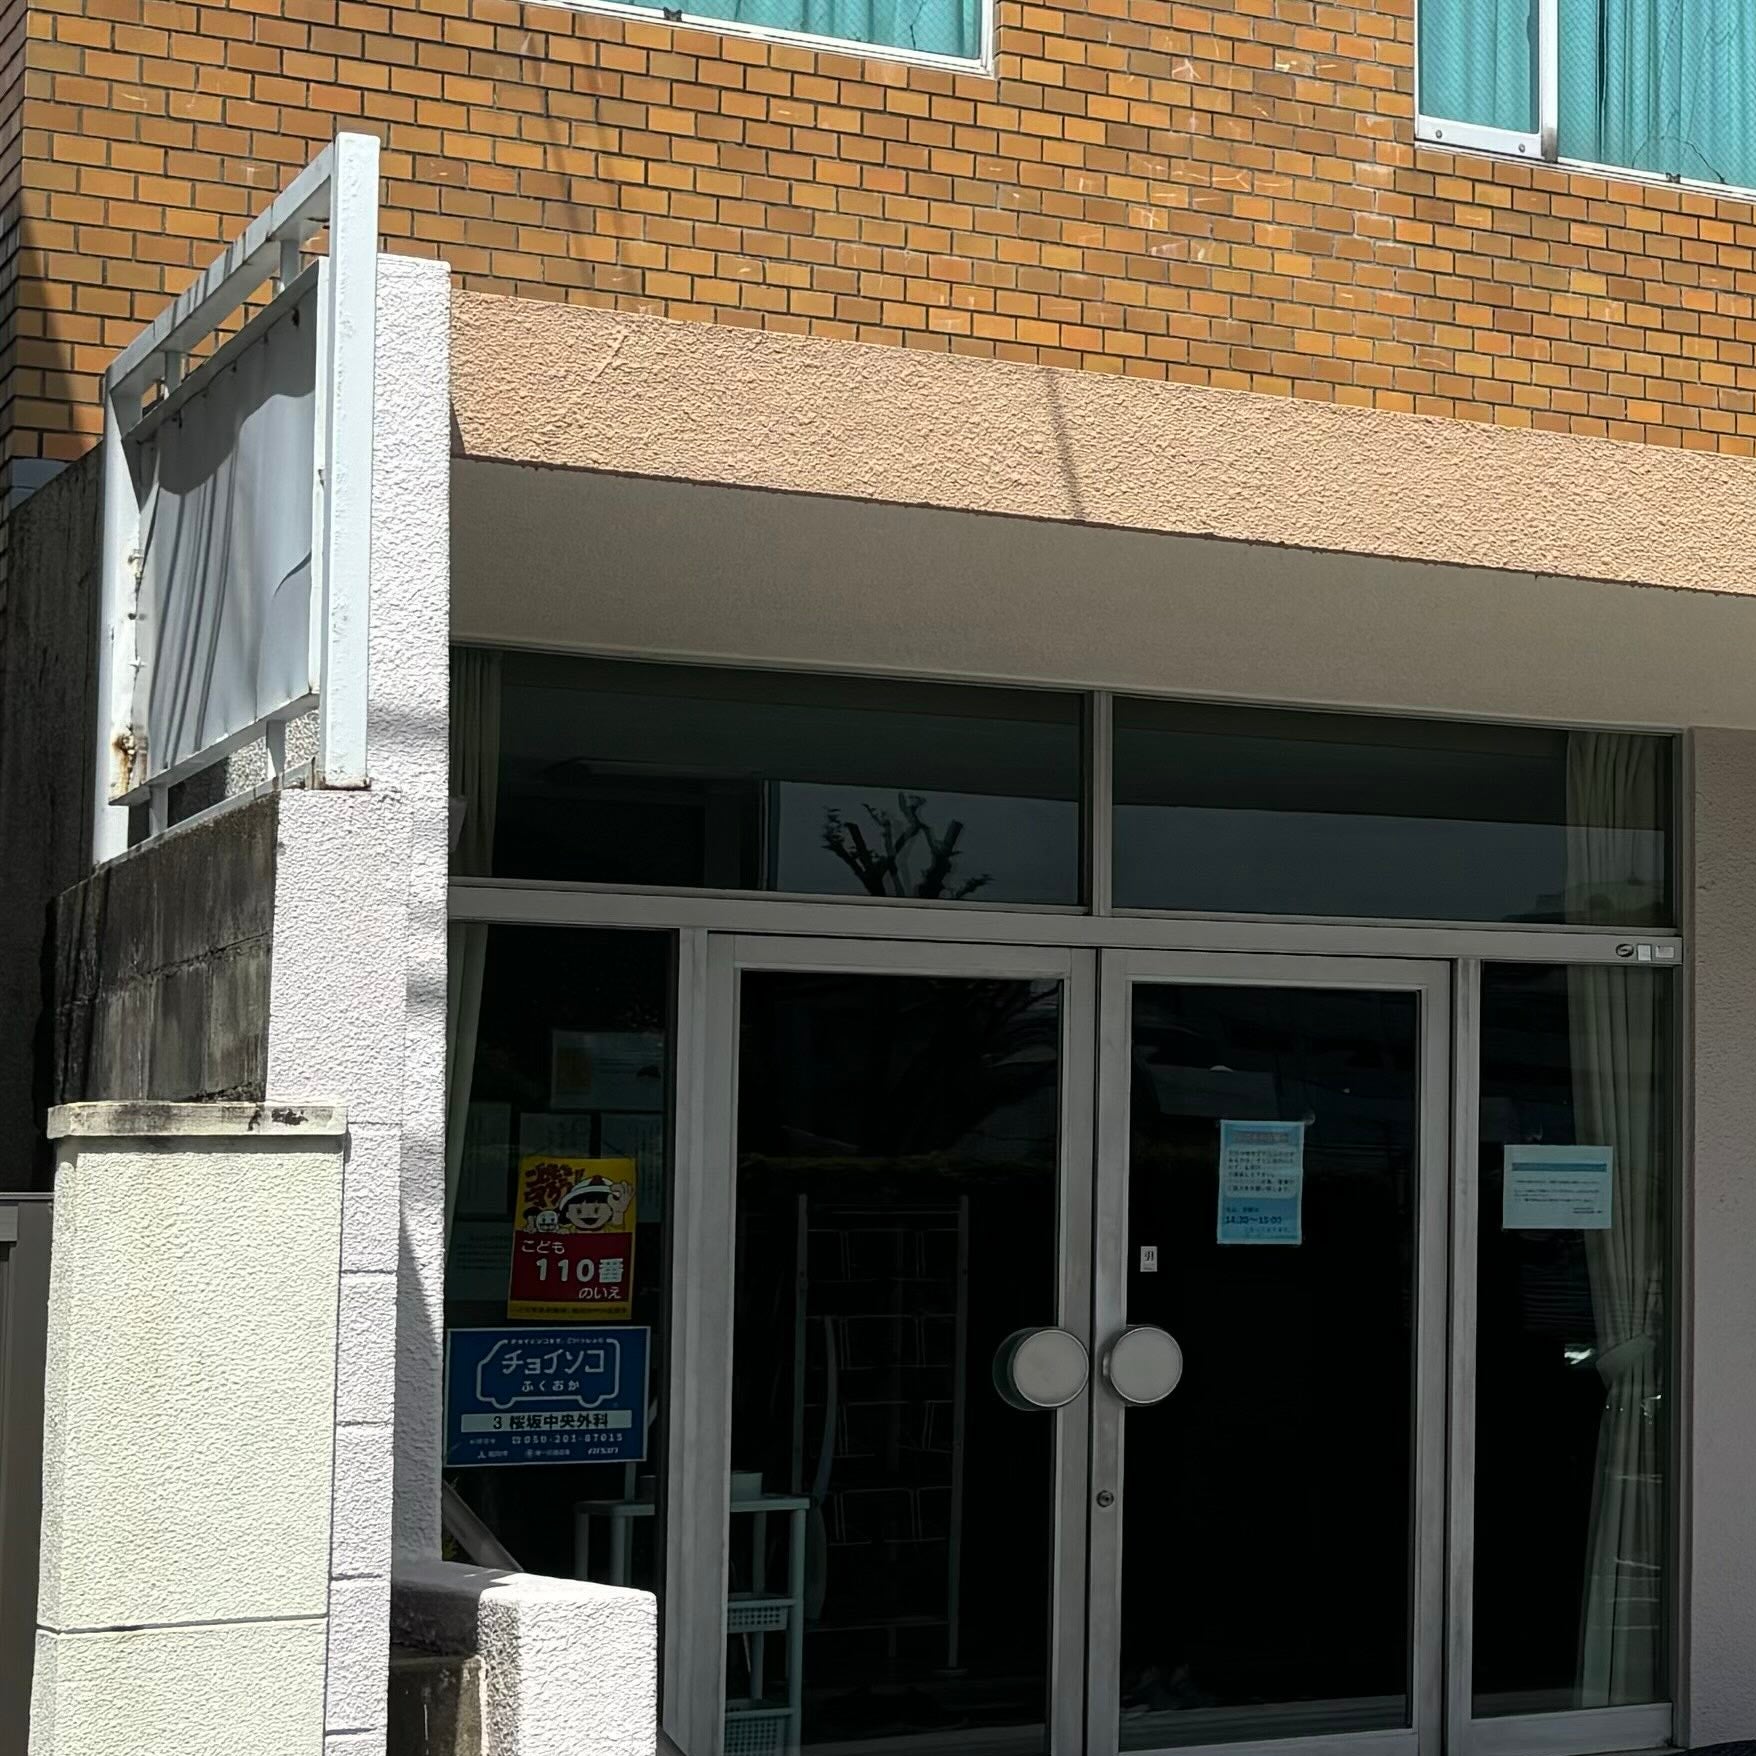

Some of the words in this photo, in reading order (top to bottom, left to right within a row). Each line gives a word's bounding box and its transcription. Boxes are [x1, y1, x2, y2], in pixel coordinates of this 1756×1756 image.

[521, 1239, 565, 1254] こども
[536, 1257, 624, 1283] 110番
[578, 1286, 622, 1299] のいえ
[501, 1349, 605, 1375] チョイソコ
[521, 1380, 580, 1392] ふくおか
[509, 1413, 608, 1430] 桜坂中央外科
